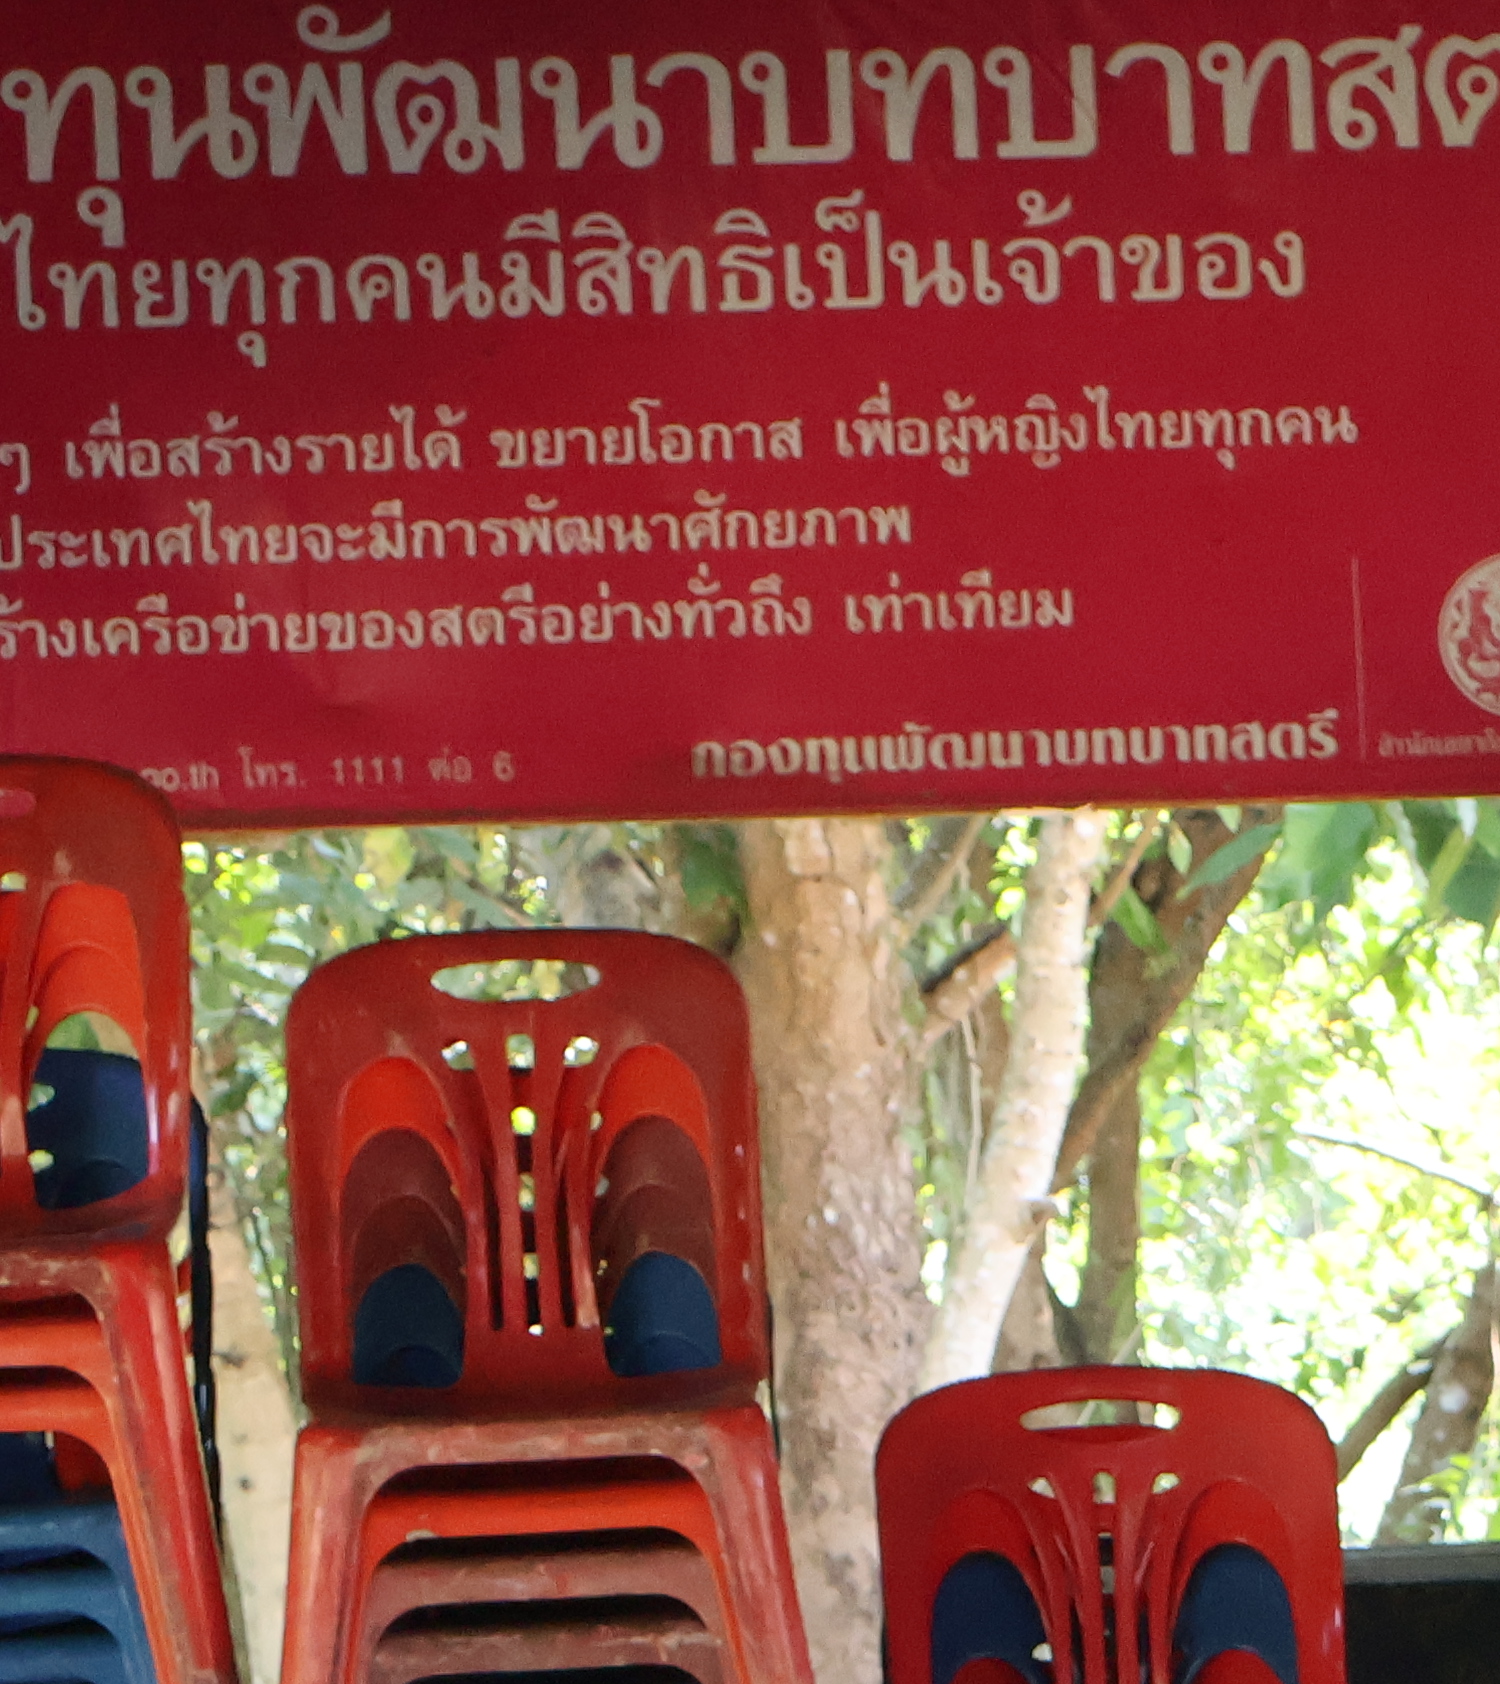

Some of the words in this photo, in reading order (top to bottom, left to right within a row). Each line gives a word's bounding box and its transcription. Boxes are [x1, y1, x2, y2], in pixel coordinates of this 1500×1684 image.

[0, 188, 1307, 368] ไทยทุกคนมีสิทธิเป็นเจ้าของ
[0, 442, 31, 495] ๆ
[65, 402, 467, 480] เพื่อสร้างรายได้
[491, 399, 803, 469] ขยายโอกาส
[835, 382, 1358, 475] เพื่อผู้หญิงไทยทุกคน
[846, 568, 1074, 635] เท่าเทียม
[333, 756, 402, 787] 1111
[429, 746, 473, 784] ต่อ
[493, 750, 516, 782] 6
[692, 709, 1338, 784] กองทุนพัฒนาบทบาทสตรี
